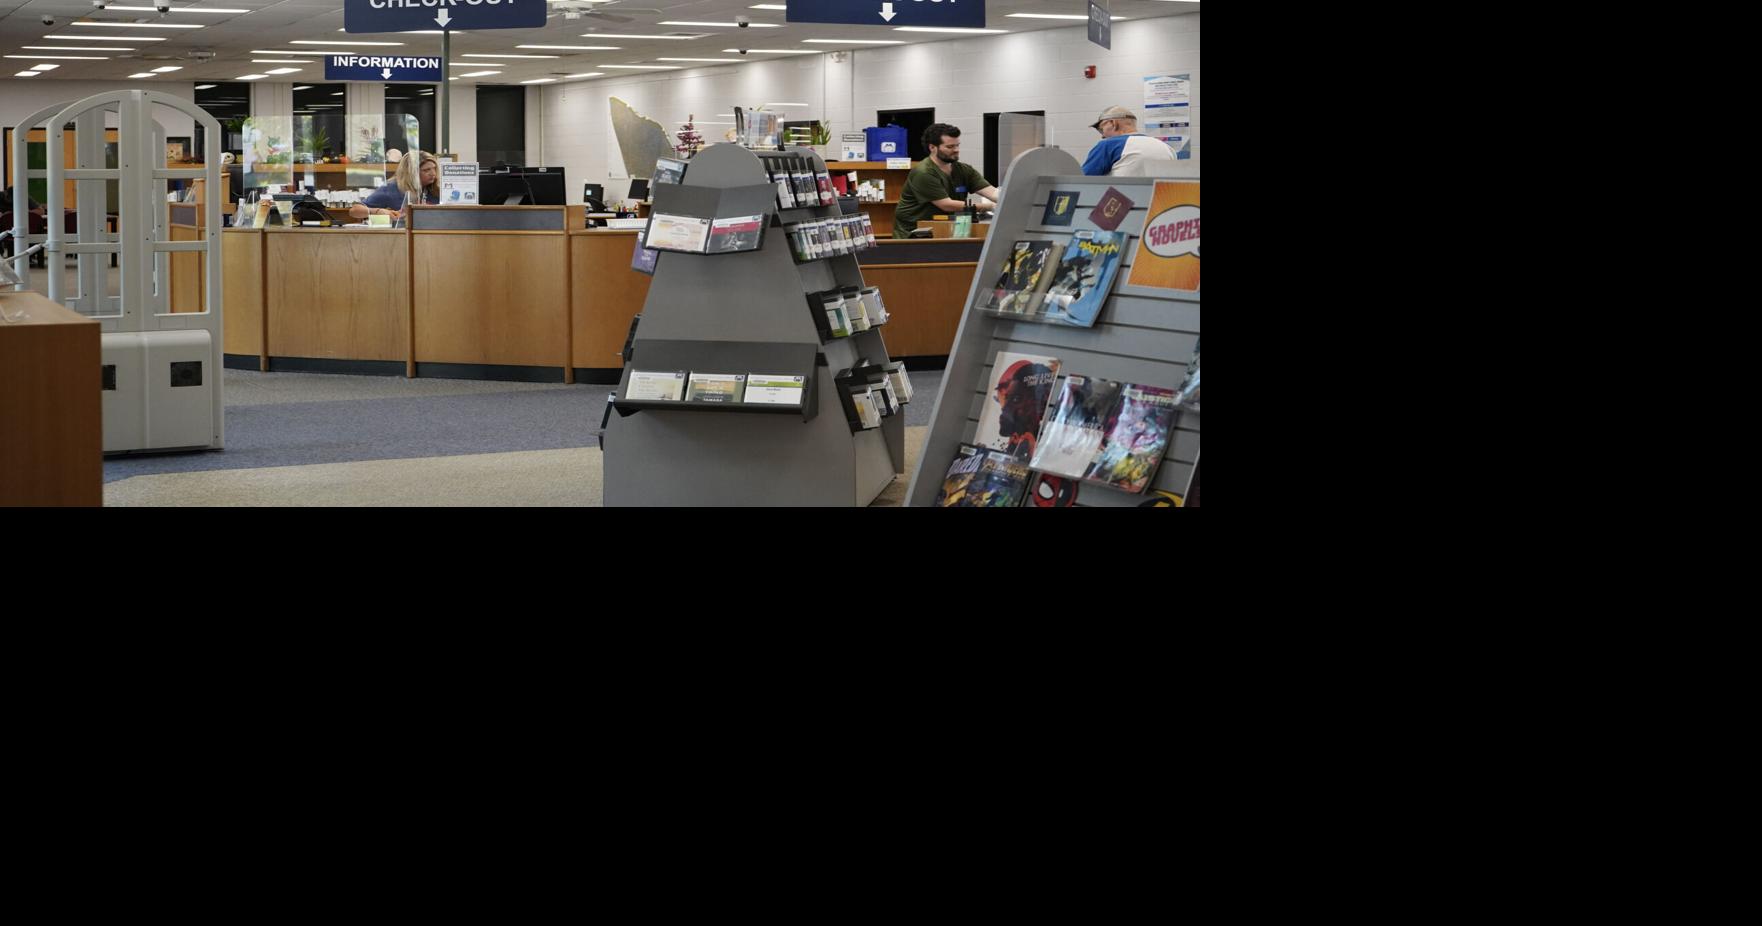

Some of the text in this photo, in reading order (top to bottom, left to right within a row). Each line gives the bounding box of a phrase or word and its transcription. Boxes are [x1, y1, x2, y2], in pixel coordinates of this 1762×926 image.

[369, 0, 514, 8] CHEC-
[333, 56, 439, 69] INFORMATION
[1079, 241, 1119, 257] BATMAN
